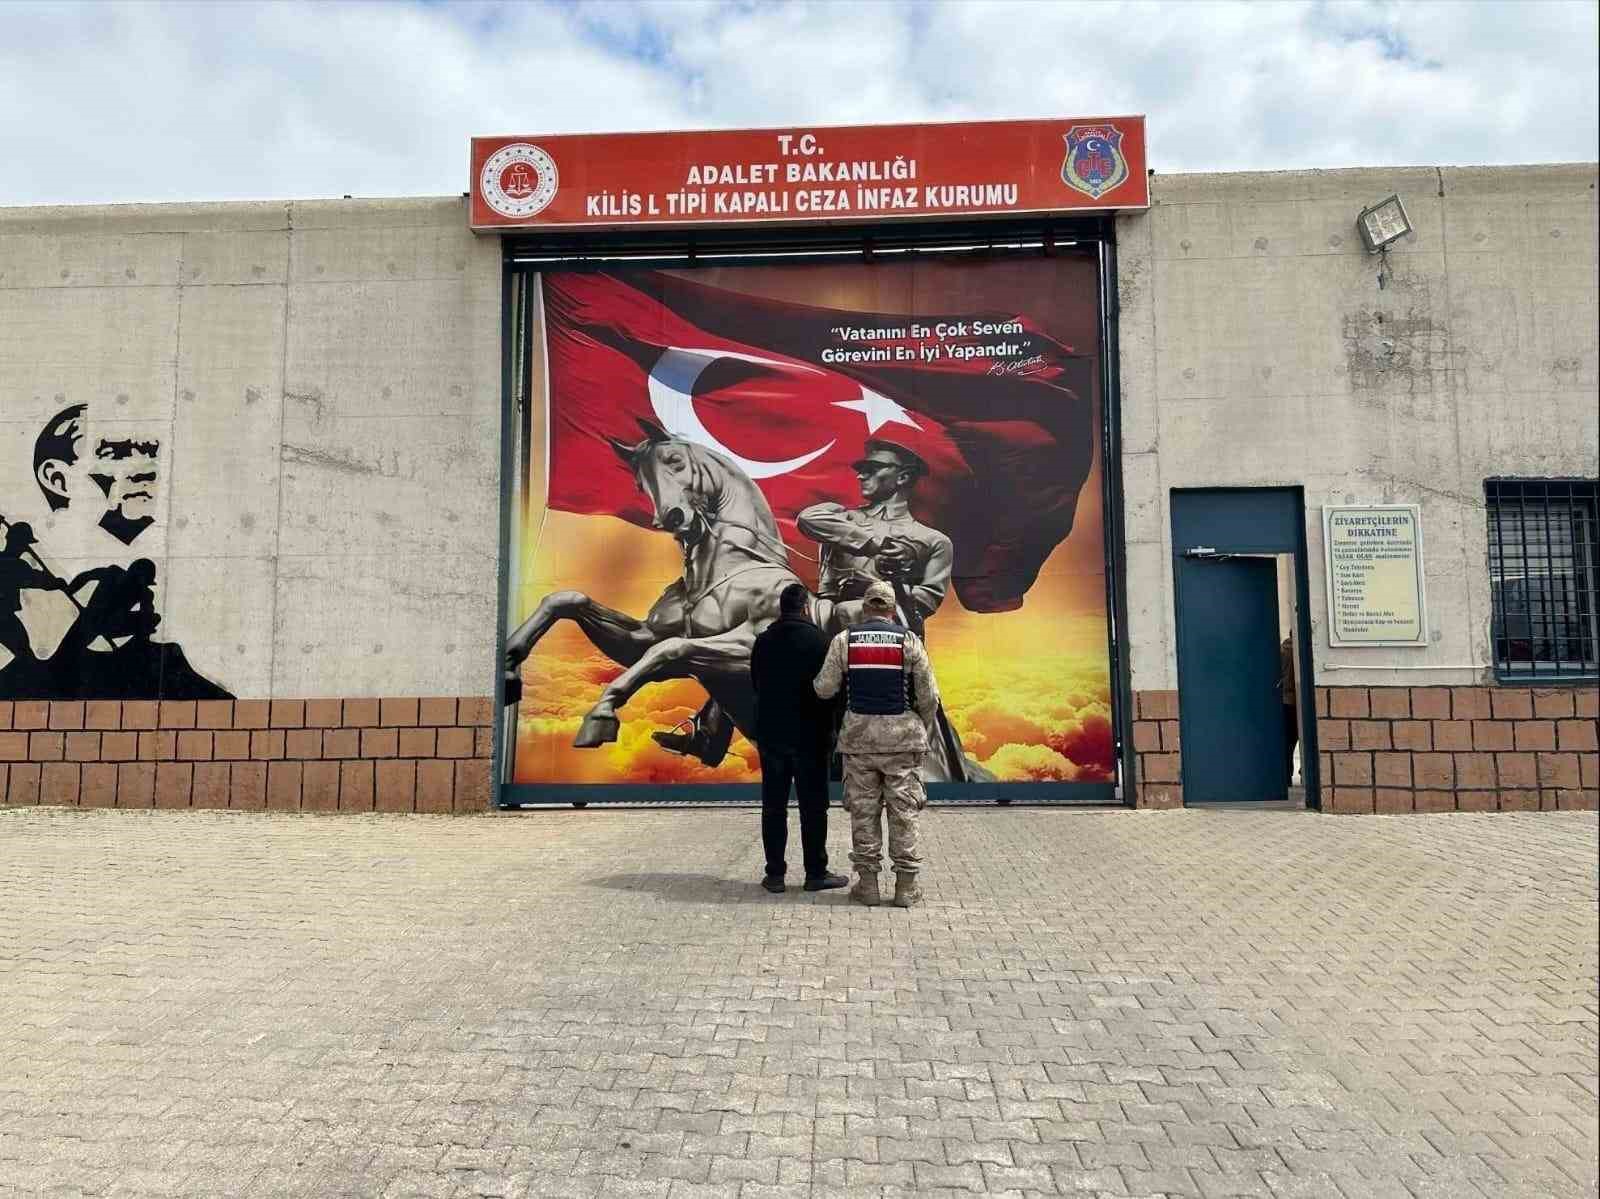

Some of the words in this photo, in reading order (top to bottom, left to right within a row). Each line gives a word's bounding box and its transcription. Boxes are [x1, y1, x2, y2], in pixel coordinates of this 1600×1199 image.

[778, 134, 824, 156] T.C.
[687, 164, 779, 185] ADALET
[786, 156, 916, 182] BAKANLIĞI
[587, 189, 643, 216] KİLİS
[648, 194, 660, 215] L
[666, 188, 707, 215] TİPİ
[714, 191, 789, 213] KAPALI
[795, 190, 850, 212] CEZA
[857, 184, 919, 210] İNFAZ
[925, 183, 1018, 208] KURUMU
[911, 324, 931, 338] En
[935, 322, 967, 341] Çok
[973, 320, 1023, 336] Seven
[821, 346, 891, 363] Görevini
[896, 345, 915, 360] En
[920, 342, 940, 362] İyi
